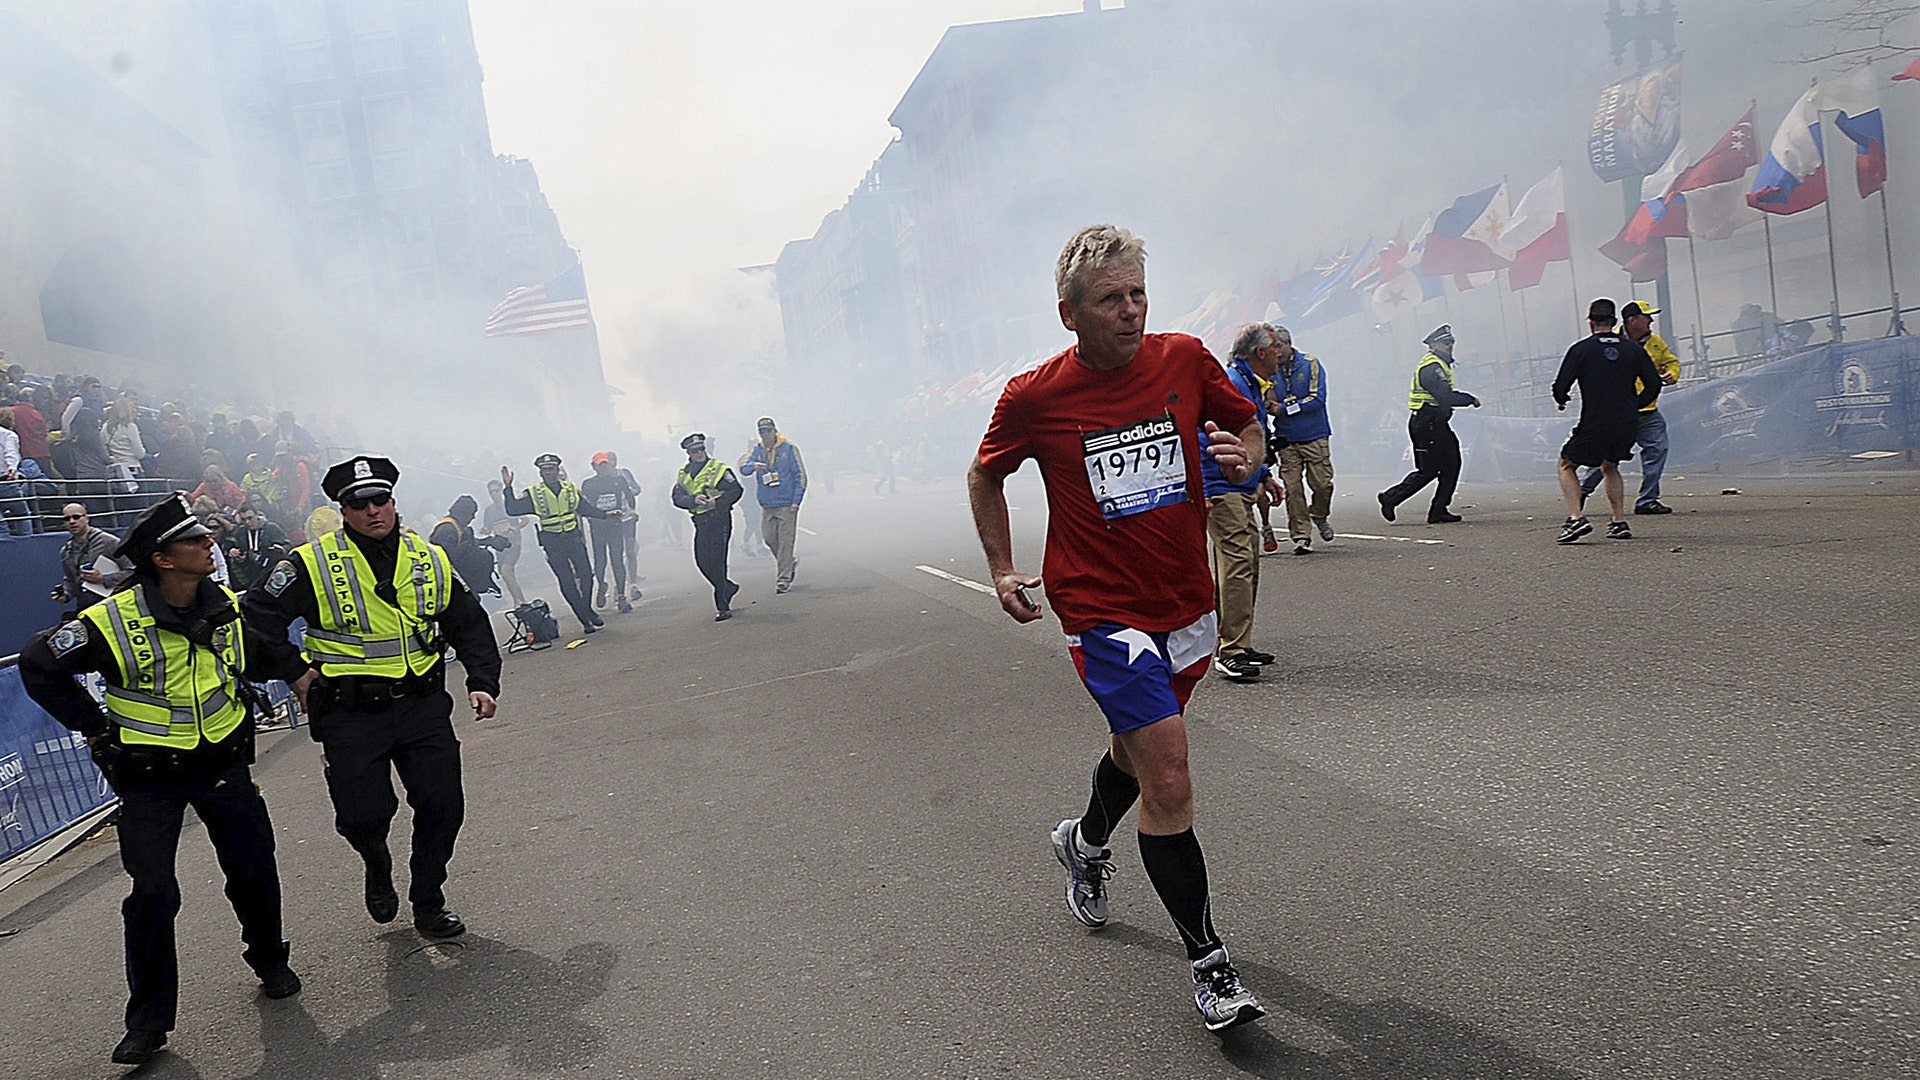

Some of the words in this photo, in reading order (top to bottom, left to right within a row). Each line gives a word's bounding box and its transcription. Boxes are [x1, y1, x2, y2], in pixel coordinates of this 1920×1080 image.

[1603, 83, 1621, 167] MARATHON
[1119, 420, 1174, 443] adidas
[1092, 438, 1179, 481] 19797
[1099, 485, 1106, 495] 2
[328, 552, 358, 627] BOSTON
